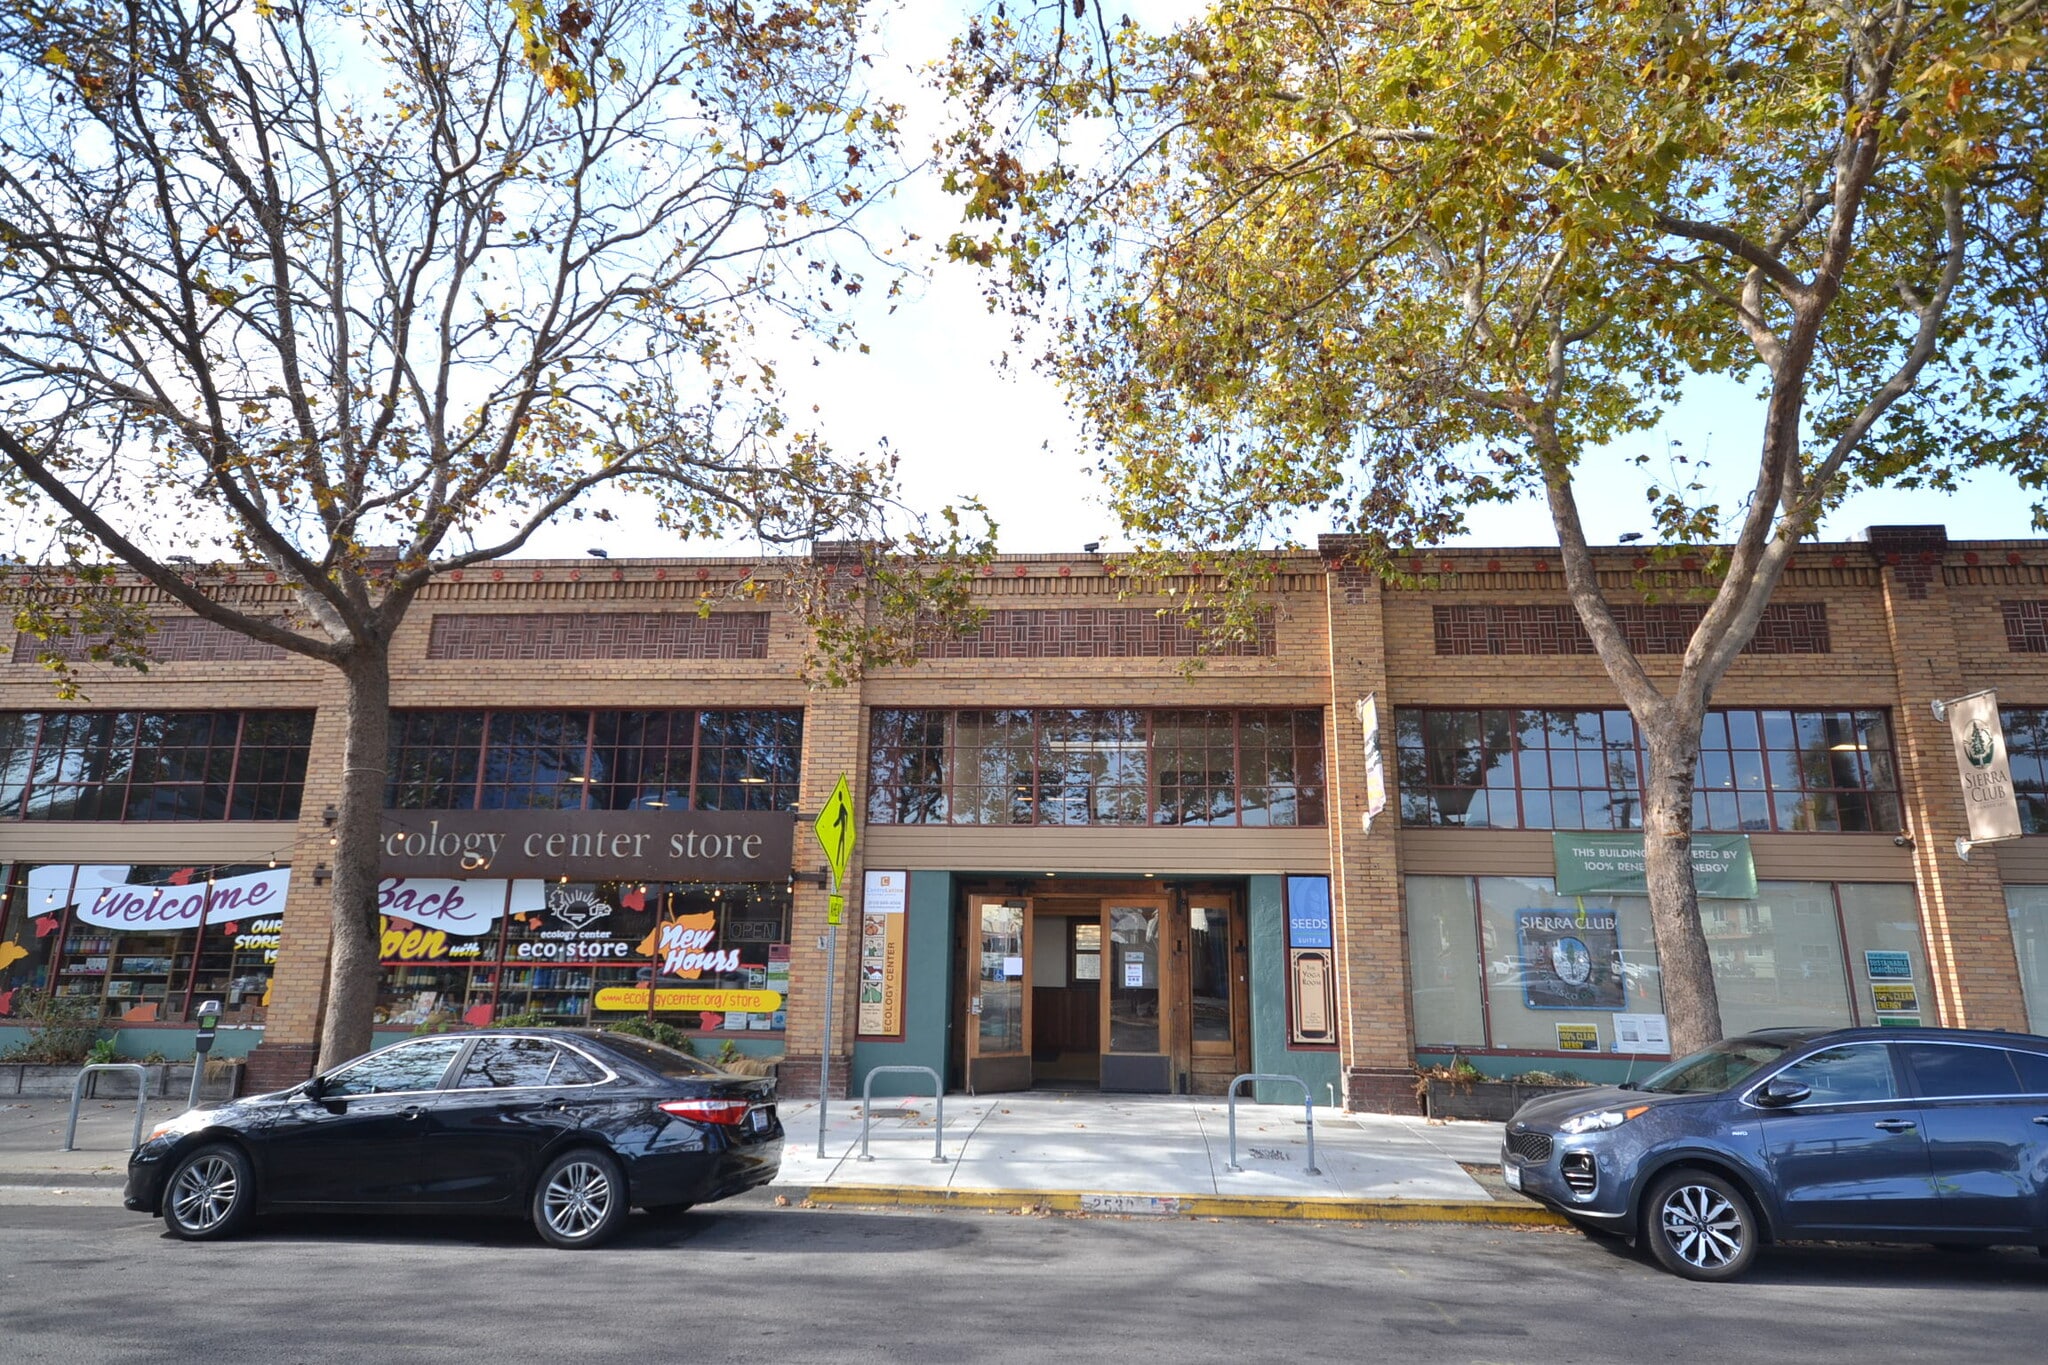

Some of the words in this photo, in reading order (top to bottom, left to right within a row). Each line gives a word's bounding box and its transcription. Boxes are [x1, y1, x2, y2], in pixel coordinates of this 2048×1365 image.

[1965, 770, 2008, 789] SIERRA
[1971, 785, 2006, 802] CLUB
[523, 829, 650, 857] center
[669, 829, 763, 858] store
[1572, 848, 1595, 858] THIS
[1692, 850, 1719, 859] ERED
[1724, 851, 1738, 860] BY
[1584, 861, 1614, 871] 100%
[1691, 864, 1729, 873] NERGY
[91, 881, 277, 922] Welcome
[379, 877, 477, 920] Back
[731, 923, 776, 939] OPEN
[1291, 918, 1328, 929] SEEDS
[1521, 917, 1573, 929] SIERRA
[1575, 917, 1615, 930] CLUB
[234, 935, 281, 950] STORE
[379, 915, 450, 960] pen
[449, 942, 481, 957] with
[540, 930, 577, 940] ecology
[580, 930, 612, 939] center
[658, 924, 716, 950] New
[264, 953, 278, 964] IS
[663, 949, 741, 974] Hours
[886, 941, 895, 981] CENTER
[884, 984, 893, 1033] ECOLOGY
